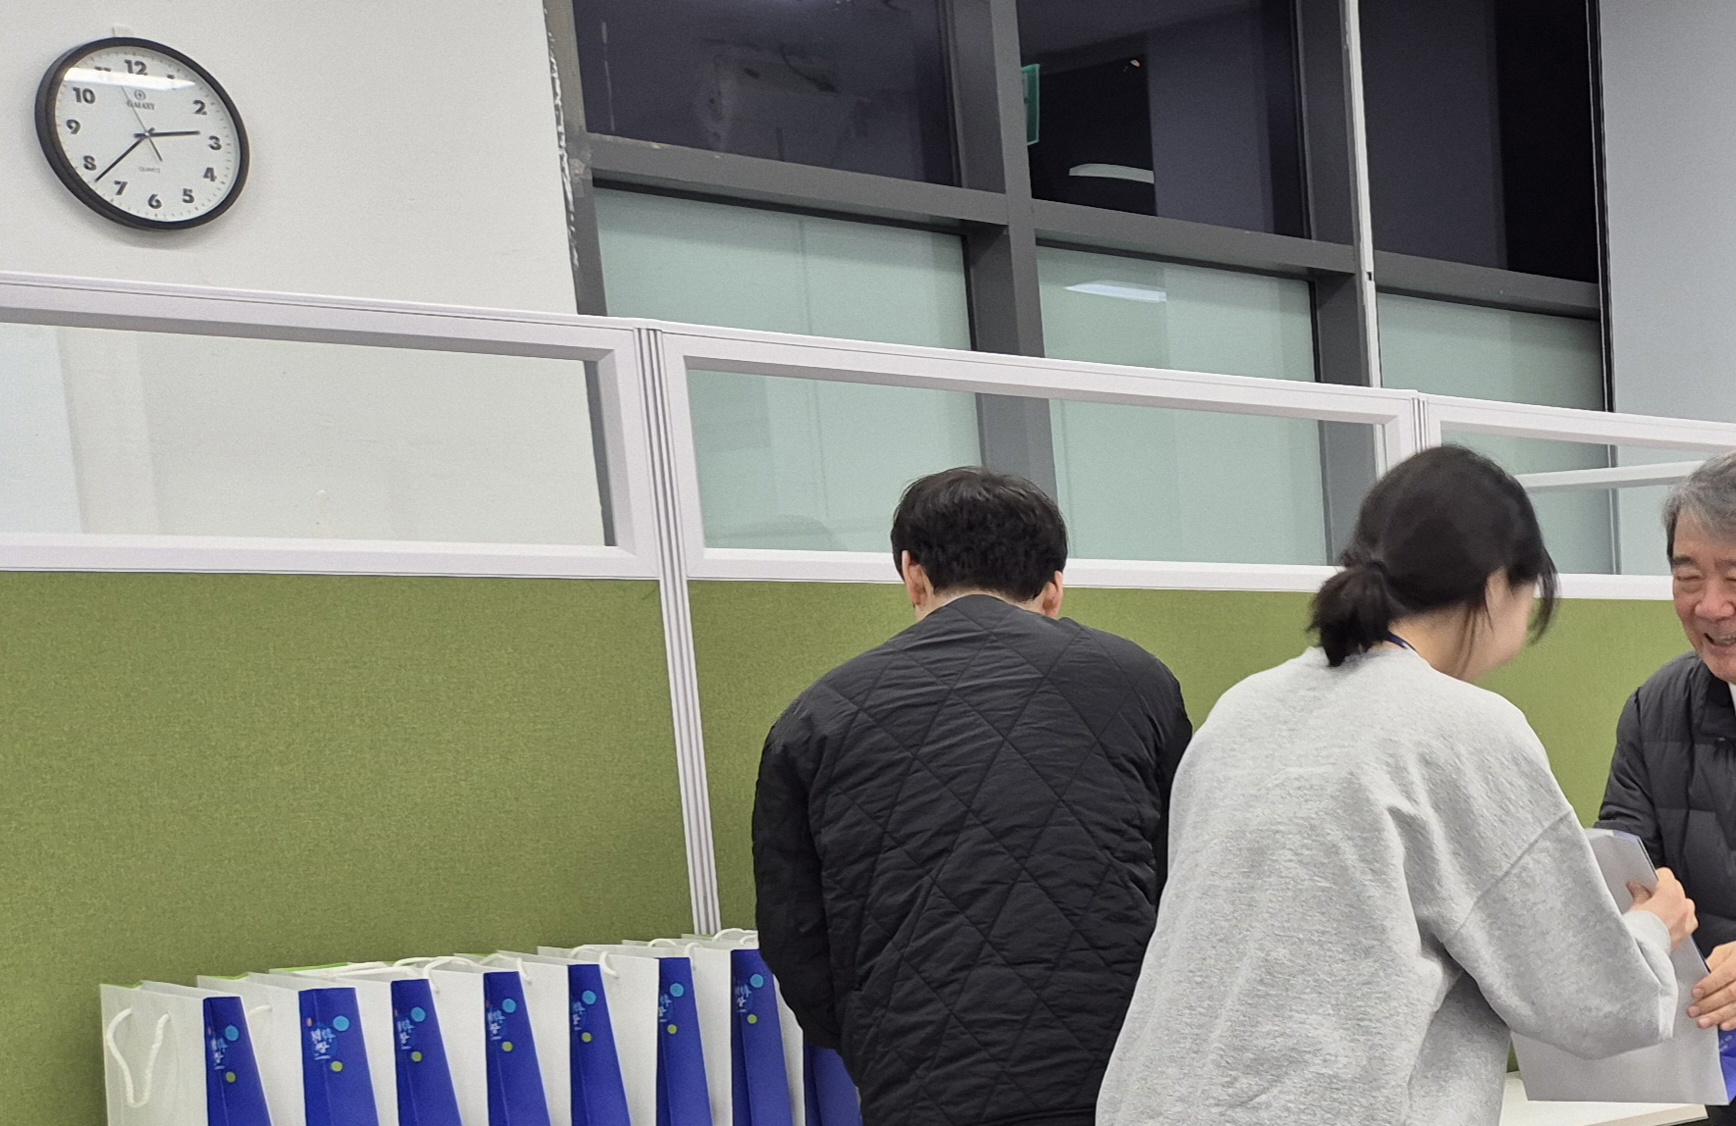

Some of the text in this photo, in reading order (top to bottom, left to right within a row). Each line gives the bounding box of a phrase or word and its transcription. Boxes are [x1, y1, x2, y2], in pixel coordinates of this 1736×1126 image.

[124, 59, 148, 76] 12
[72, 87, 96, 104] 10
[192, 99, 208, 116] 2
[66, 118, 81, 135] 9
[207, 135, 222, 151] 3
[83, 155, 97, 171] 8
[202, 167, 217, 182] 4
[113, 180, 128, 195] 7
[147, 194, 162, 210] 6
[182, 188, 195, 204] 5
